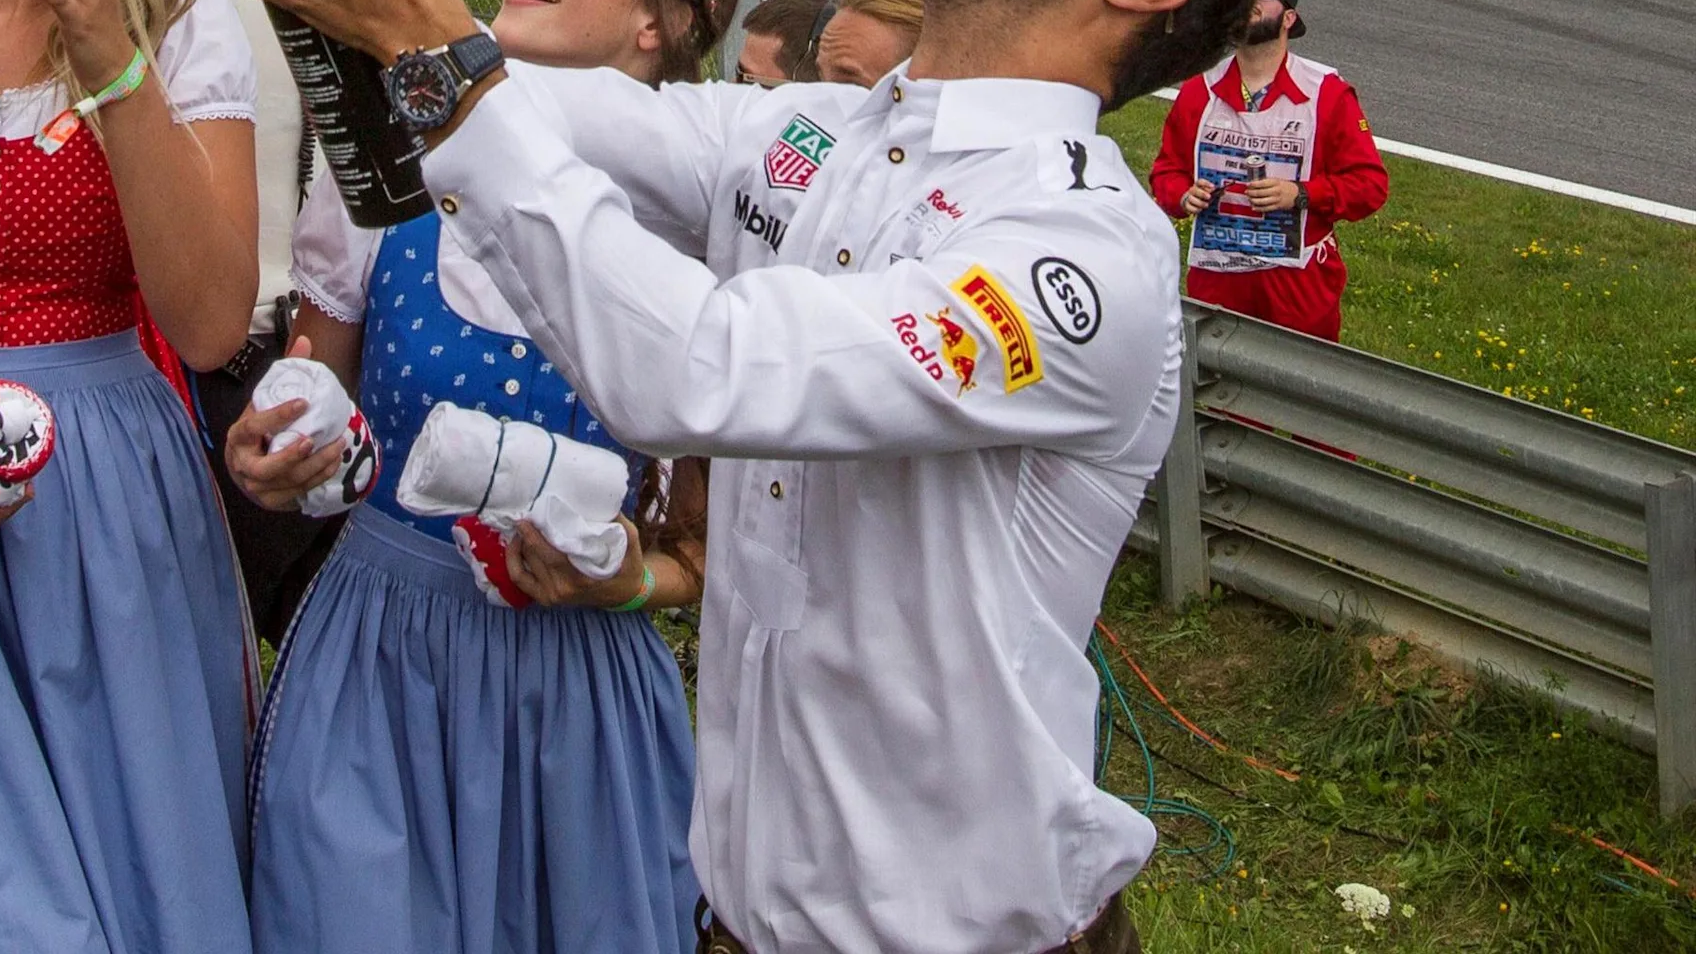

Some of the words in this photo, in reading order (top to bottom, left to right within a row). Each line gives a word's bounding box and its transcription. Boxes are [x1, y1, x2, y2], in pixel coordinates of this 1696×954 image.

[1202, 225, 1286, 247] COURSE
[962, 275, 1034, 382] PIRELLI
[1045, 266, 1091, 332] ESSO
[890, 313, 937, 365] Red
